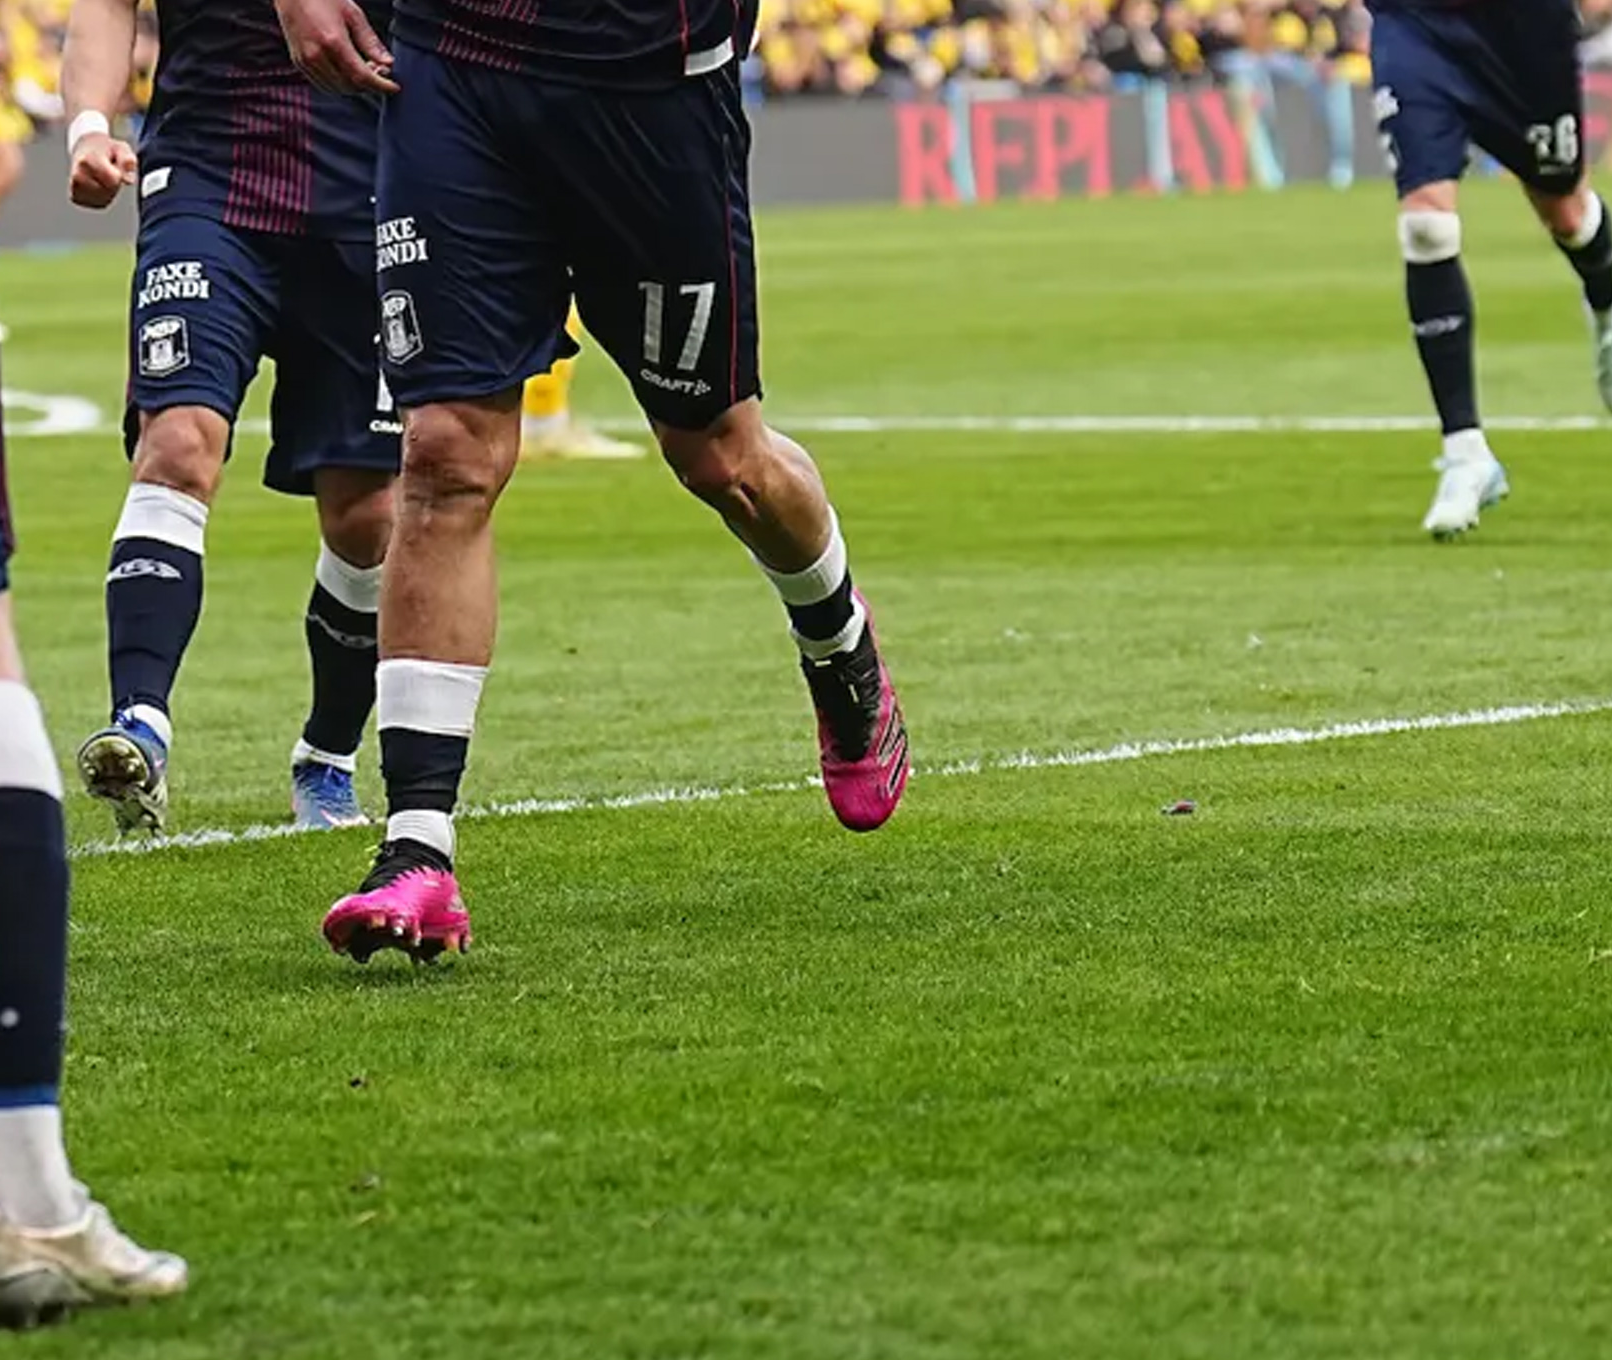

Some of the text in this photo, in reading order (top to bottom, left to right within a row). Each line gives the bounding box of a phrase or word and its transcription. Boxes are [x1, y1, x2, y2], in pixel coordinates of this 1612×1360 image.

[146, 261, 203, 286] FAXE
[138, 280, 210, 309] KONDI
[637, 281, 716, 371] 17
[640, 368, 695, 394] CRAFT
